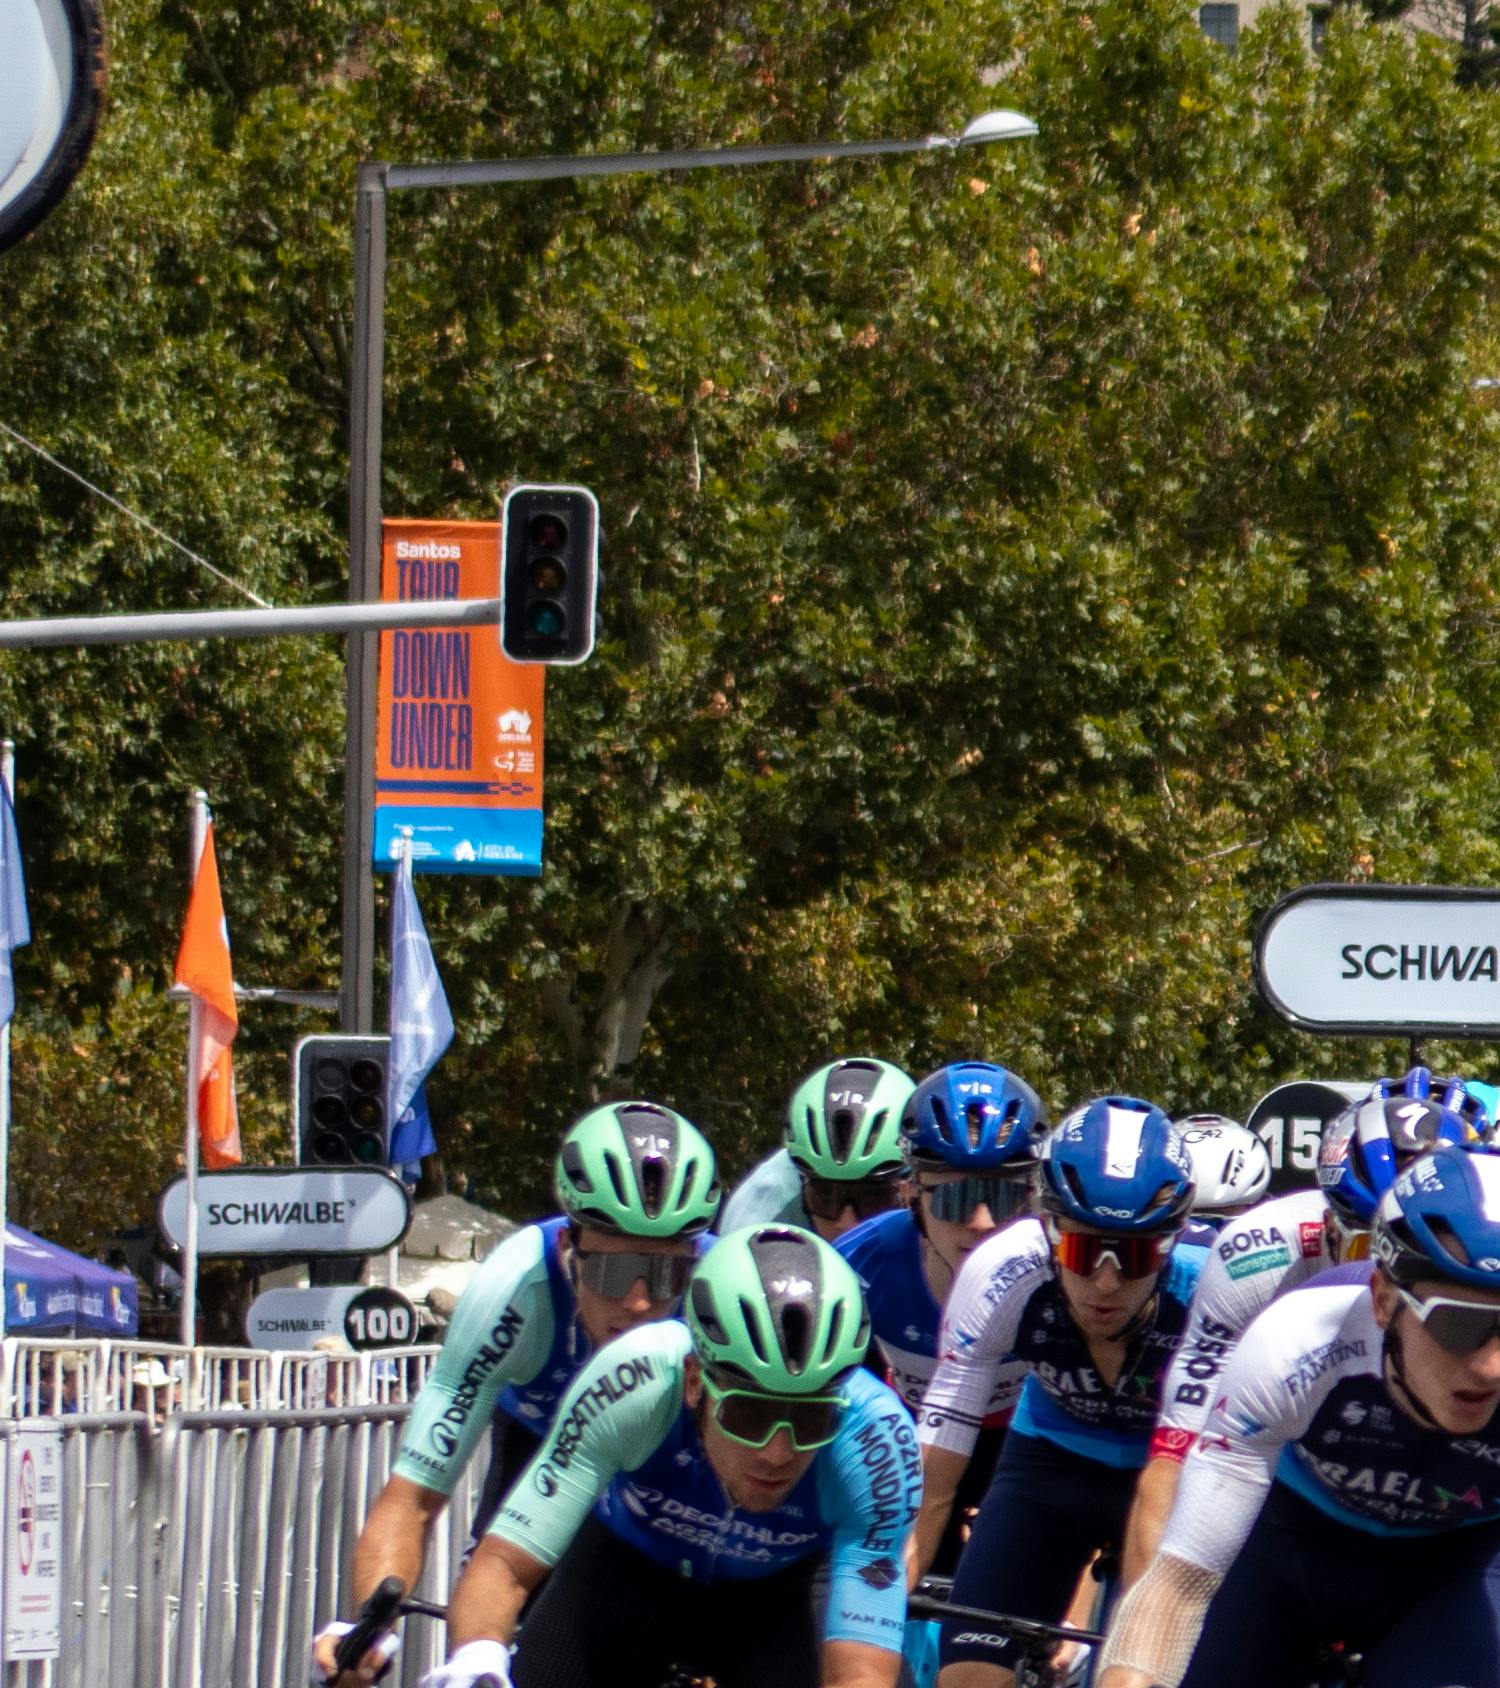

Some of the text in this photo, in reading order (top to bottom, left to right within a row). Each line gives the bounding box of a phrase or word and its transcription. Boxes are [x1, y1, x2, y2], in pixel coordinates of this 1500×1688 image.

[397, 541, 461, 559] Santos
[392, 631, 470, 699] DOWN
[389, 702, 473, 770] UNDER
[1262, 1117, 1322, 1169] 15
[207, 1201, 346, 1226] SCHWALBE
[1218, 1227, 1286, 1261] BORA
[257, 1307, 411, 1340] SCHWALBE 100
[444, 1306, 525, 1425] DECATHLON
[1175, 1315, 1234, 1406] BOSS
[1284, 1340, 1367, 1396] FANTINI
[552, 1356, 655, 1469] DECATHLON
[881, 1412, 922, 1483] AG2R
[854, 1423, 902, 1552] MONDIALE
[841, 1610, 876, 1625] VAN
